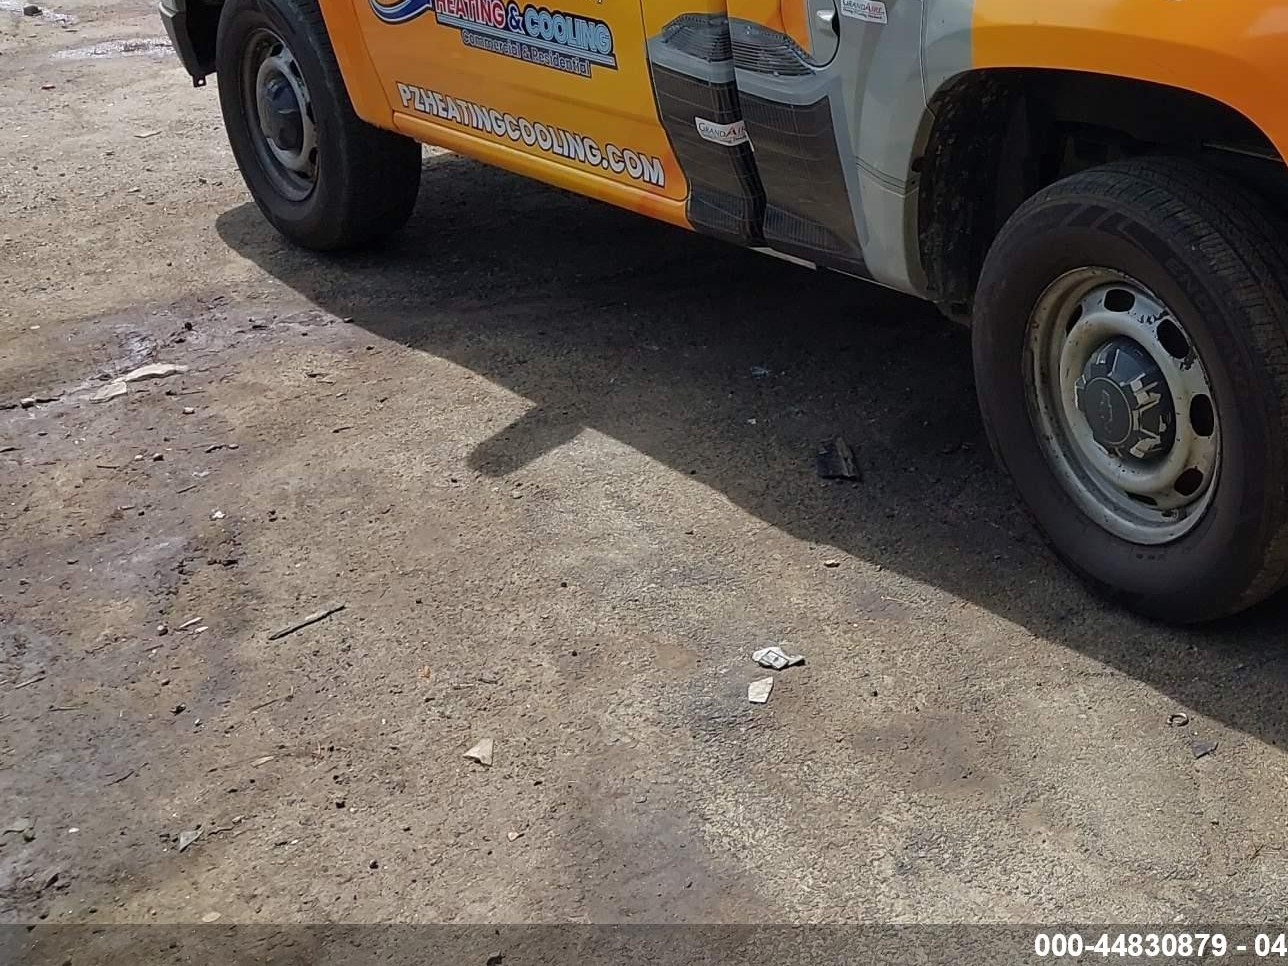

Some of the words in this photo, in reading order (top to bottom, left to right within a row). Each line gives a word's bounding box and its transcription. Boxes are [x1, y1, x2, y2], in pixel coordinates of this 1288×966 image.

[462, 30, 521, 59] Commercial
[522, 44, 532, 60] &
[532, 48, 591, 76] Residential
[507, 3, 526, 34] &
[524, 7, 613, 55] COOLING
[397, 82, 665, 188] PZHEATINGCOOLING.COM
